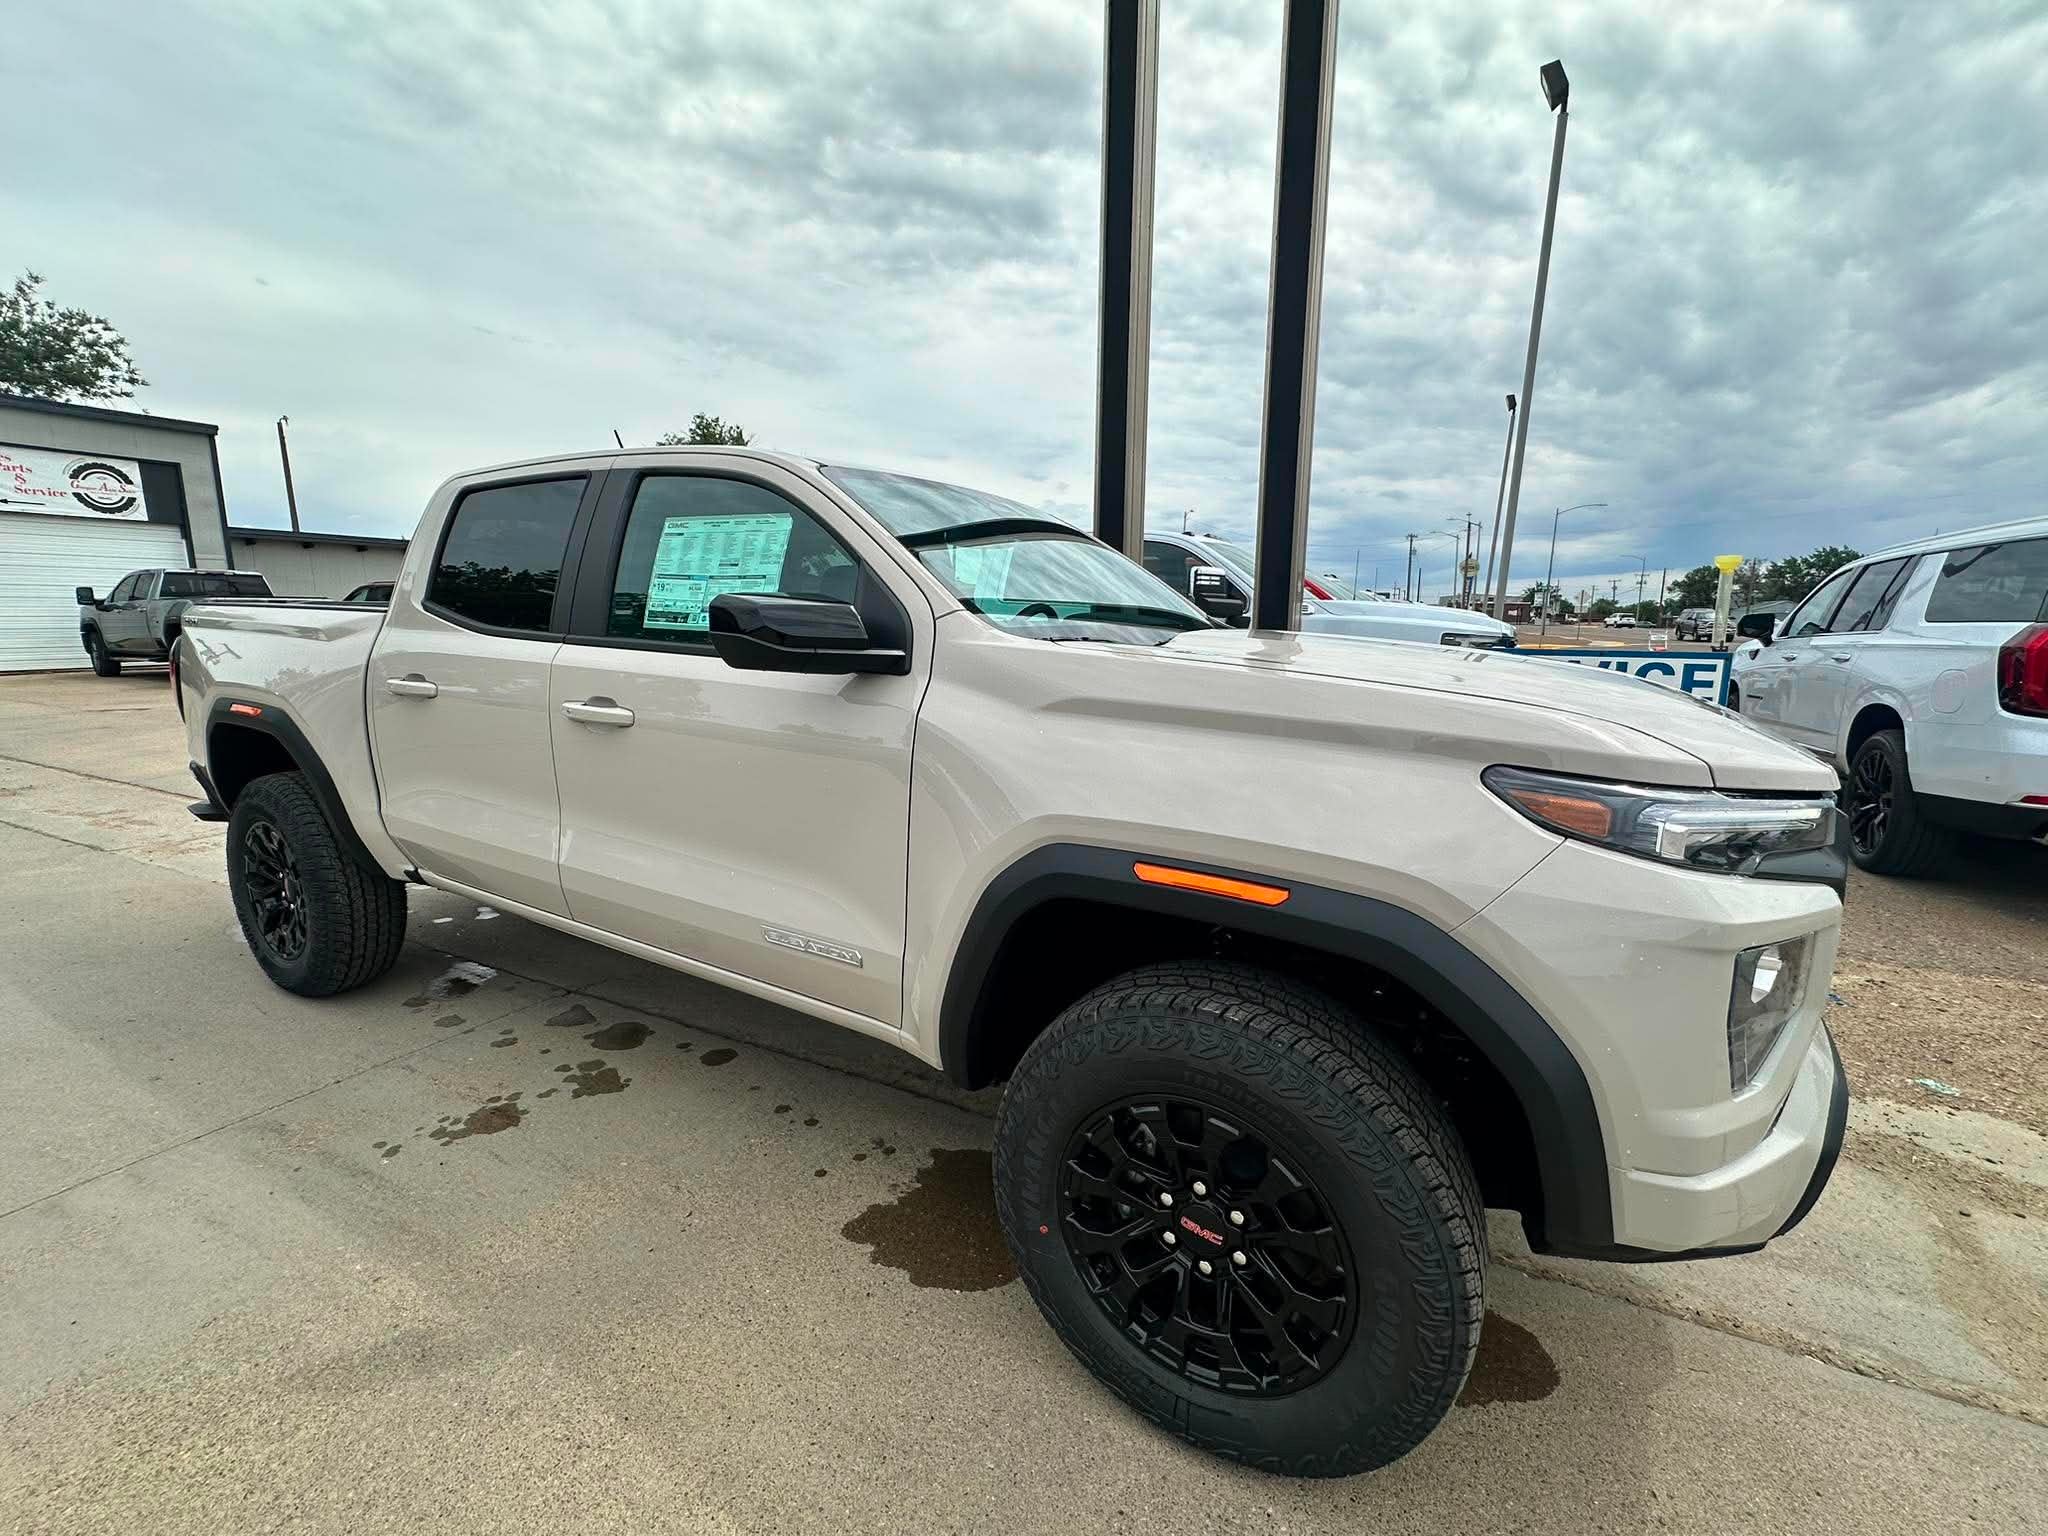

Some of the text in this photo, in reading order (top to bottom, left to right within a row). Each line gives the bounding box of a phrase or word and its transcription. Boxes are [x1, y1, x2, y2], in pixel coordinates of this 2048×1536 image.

[15, 473, 26, 484] &
[14, 485, 67, 497] Service
[1180, 1215, 1223, 1246] GMC
